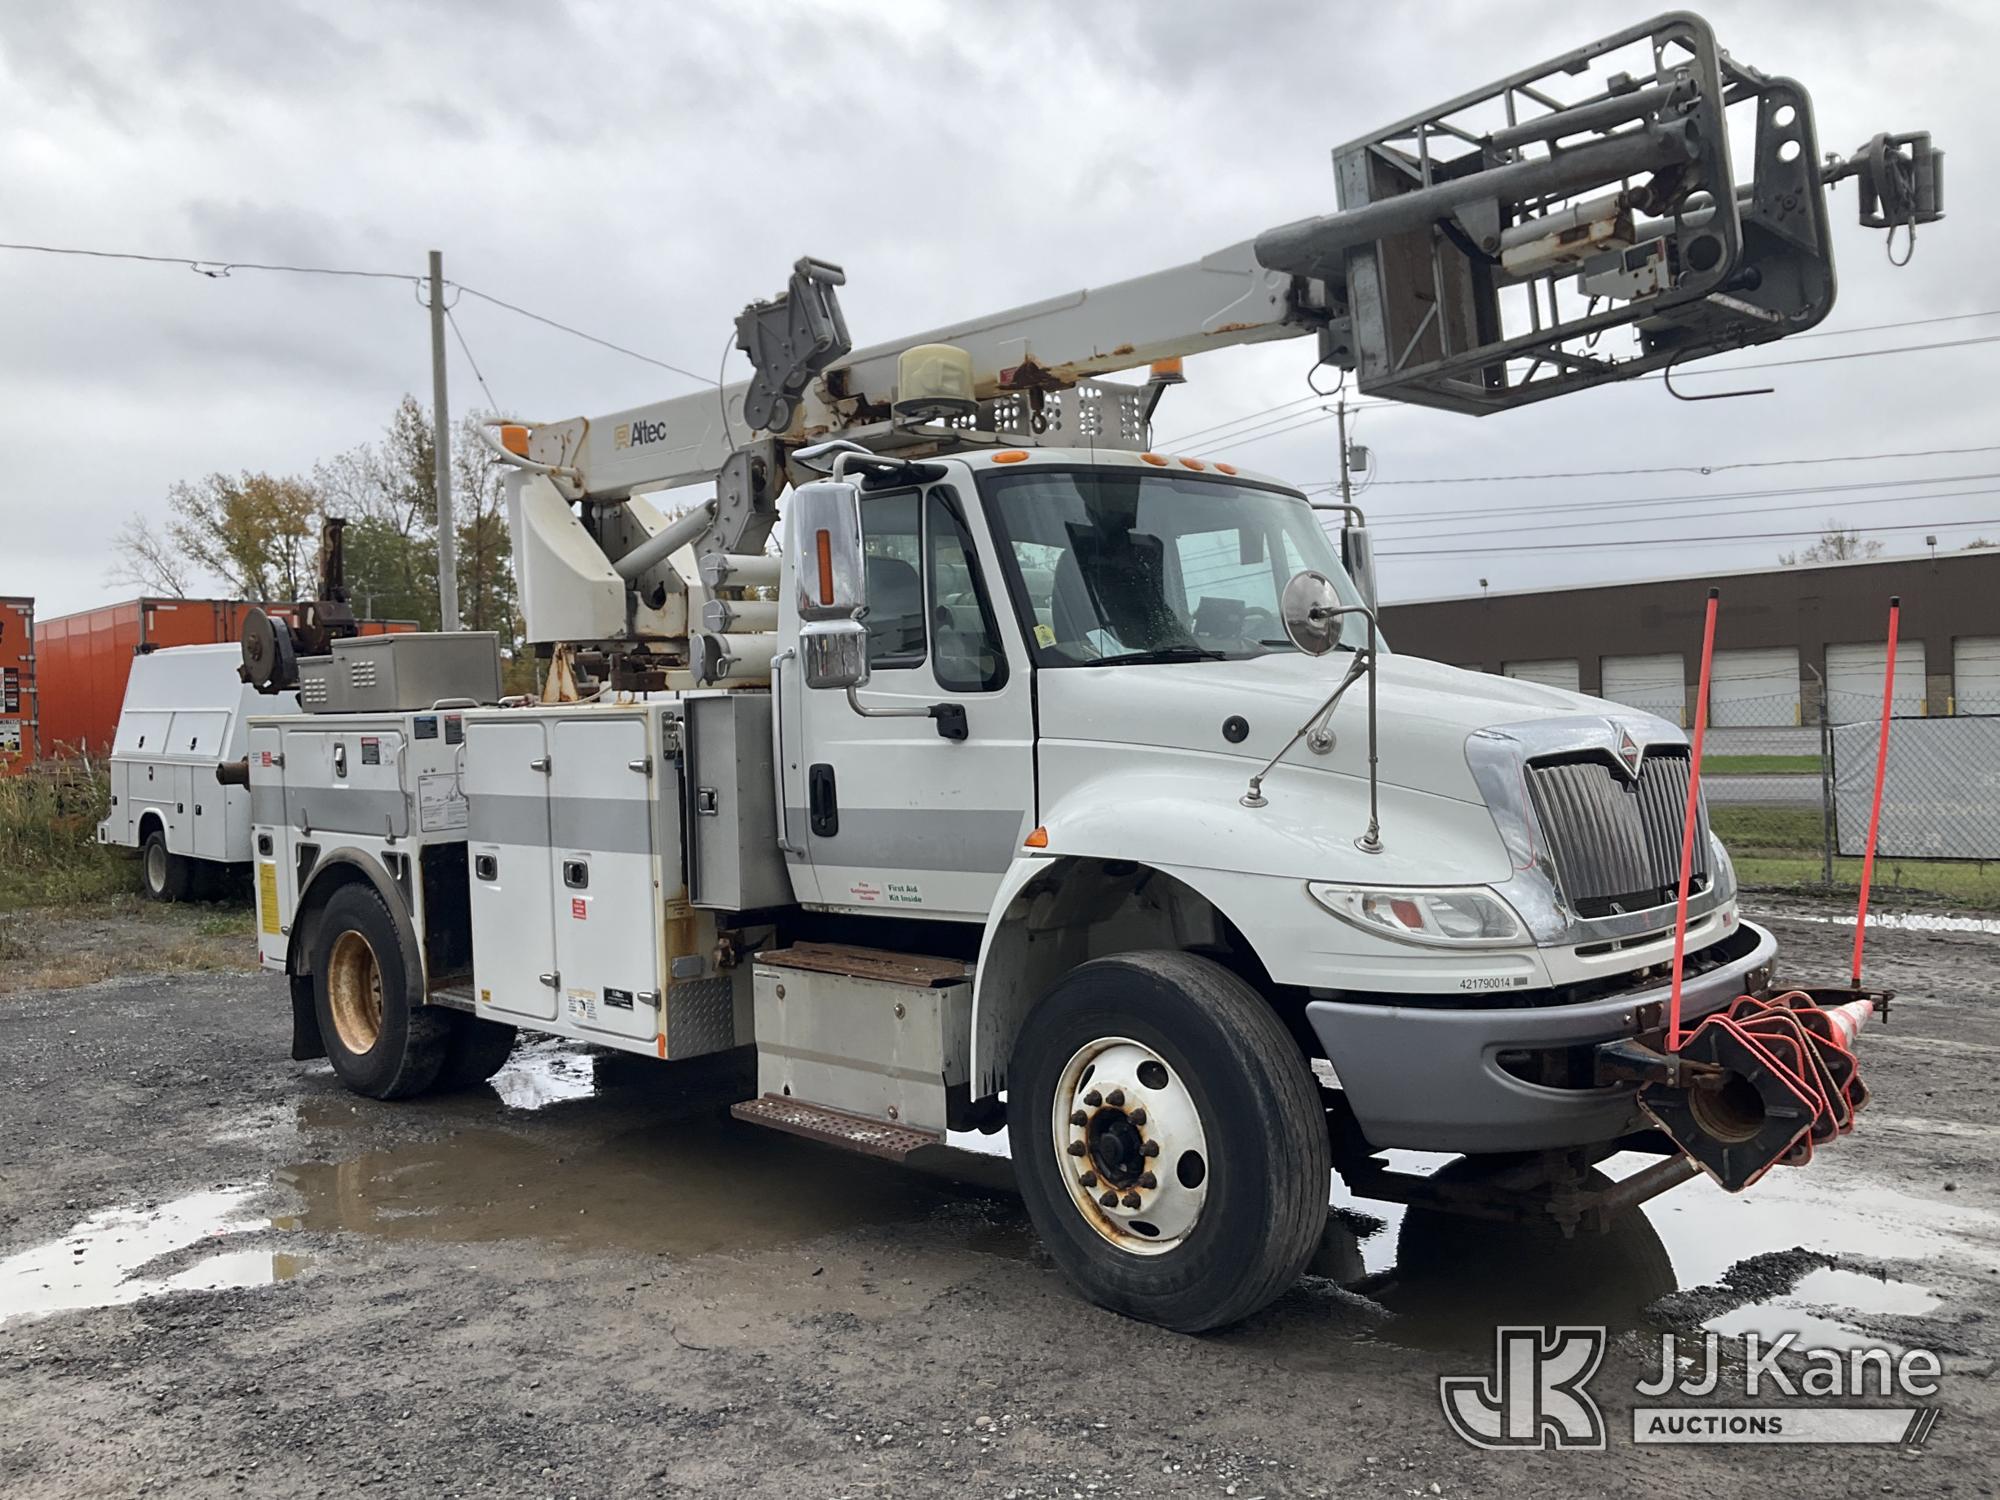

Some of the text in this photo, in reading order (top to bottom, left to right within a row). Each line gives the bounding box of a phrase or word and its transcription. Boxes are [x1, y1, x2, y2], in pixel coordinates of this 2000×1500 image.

[631, 419, 667, 447] Altec
[888, 884, 904, 892] First
[900, 895, 922, 903] Inside
[1460, 977, 1510, 989] 421790014
